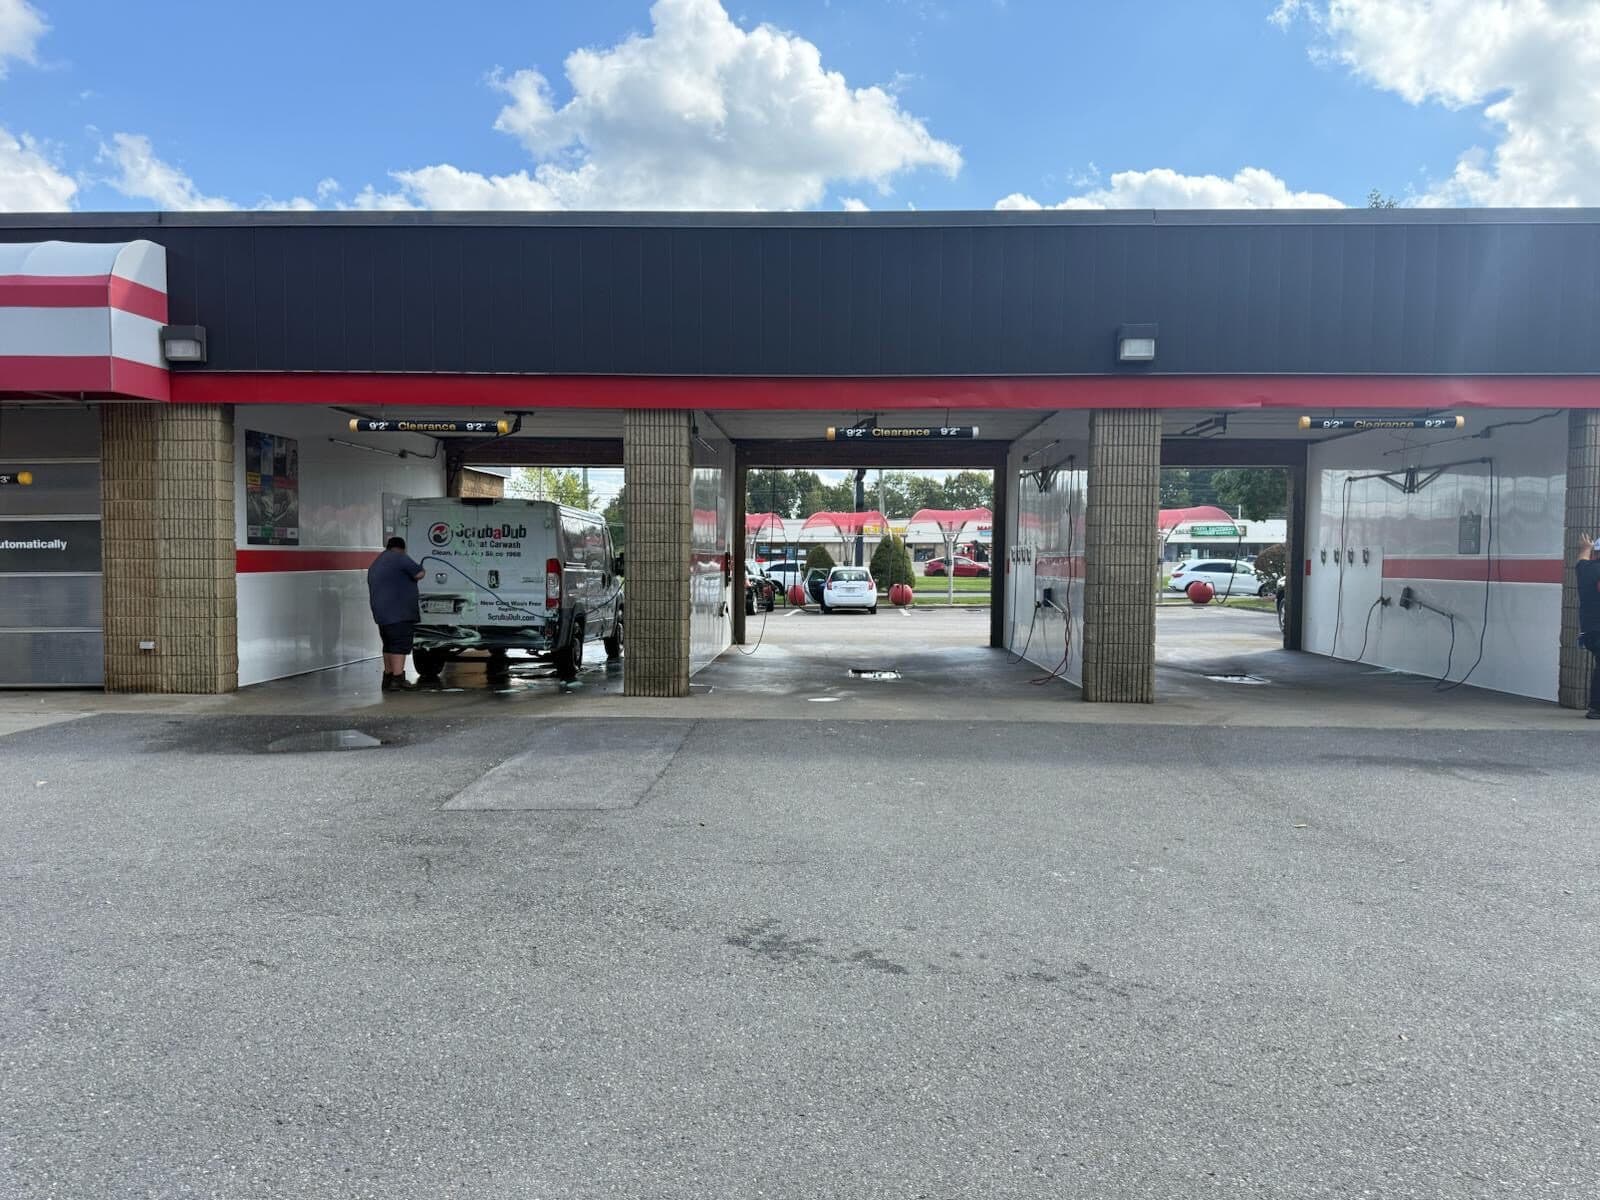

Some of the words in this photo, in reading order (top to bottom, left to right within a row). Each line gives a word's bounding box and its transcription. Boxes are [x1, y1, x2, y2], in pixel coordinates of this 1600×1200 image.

[398, 421, 456, 431] Clearance
[1353, 420, 1414, 430] Clearance
[872, 427, 930, 437] Clearance
[489, 539, 521, 549] Carwash
